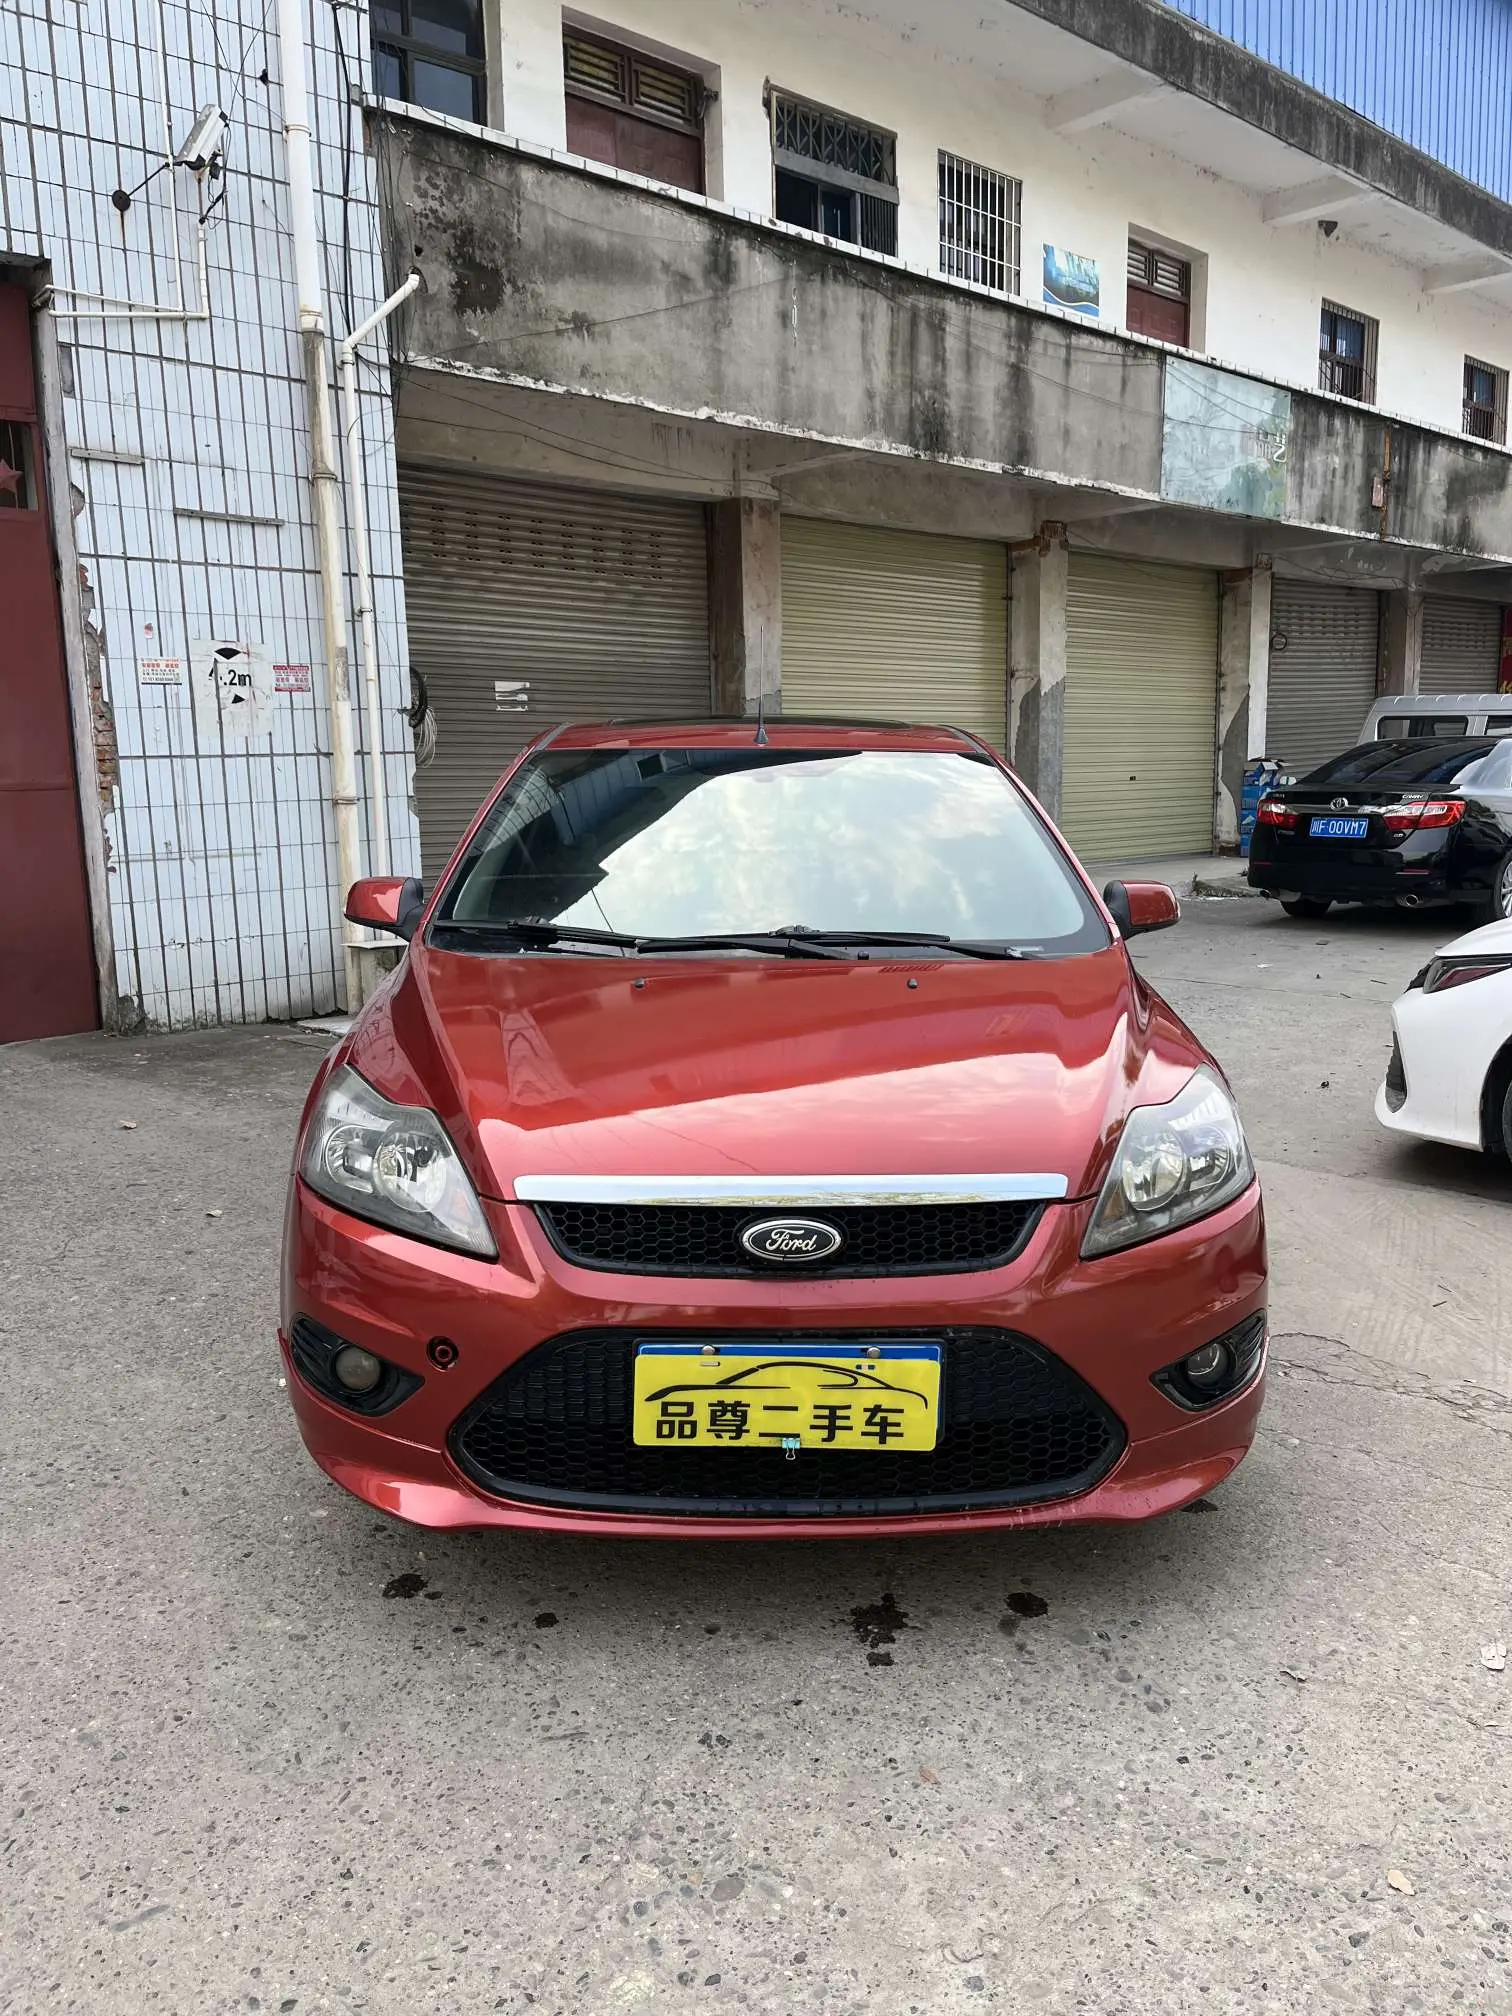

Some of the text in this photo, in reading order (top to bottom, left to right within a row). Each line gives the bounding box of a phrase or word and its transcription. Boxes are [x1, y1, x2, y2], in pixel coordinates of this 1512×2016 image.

[765, 1228, 816, 1251] Ford
[656, 1400, 904, 1445] 品尊二手车
